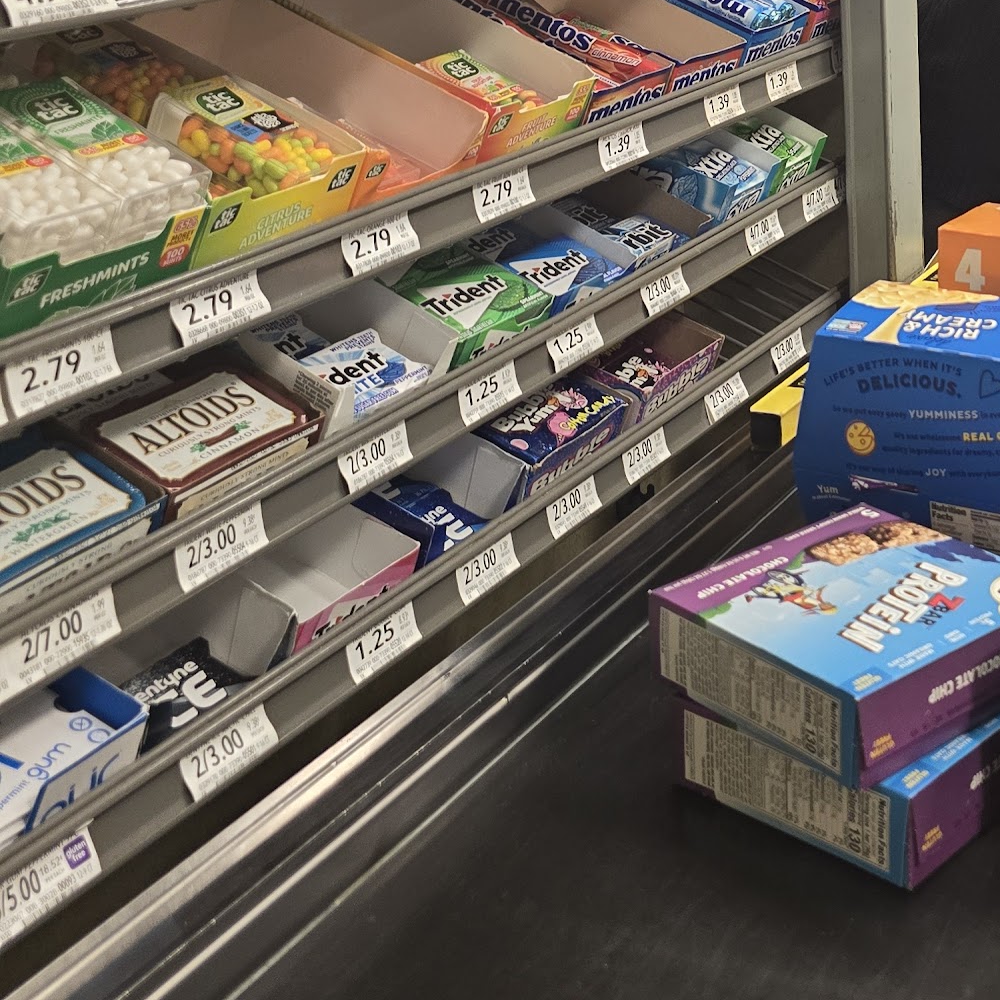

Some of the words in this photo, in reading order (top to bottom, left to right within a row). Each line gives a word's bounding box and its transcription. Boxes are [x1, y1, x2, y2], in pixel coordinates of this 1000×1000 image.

[590, 46, 643, 67] cinnamon
[746, 29, 803, 64] mentos
[770, 72, 788, 89] 1.39
[588, 83, 665, 124] mentos
[708, 95, 730, 114] 1.39
[506, 116, 557, 148] ADVENTURE
[604, 134, 631, 156] 1.39
[480, 183, 512, 208] 2.79
[240, 206, 312, 250] ADVENTURE
[748, 218, 770, 240] 4/7.00
[350, 228, 391, 260] 2.79
[39, 250, 151, 308] FRESHMINTS
[520, 249, 588, 288] Trident
[954, 248, 986, 291] 4
[422, 273, 506, 318] Trident
[645, 277, 672, 302] 2/3.00
[182, 288, 232, 326] 2.79
[903, 308, 998, 331] CREAMY
[903, 319, 922, 334] &
[928, 323, 980, 340] RICH
[553, 332, 586, 356] 1.25
[21, 350, 81, 393] 2.79
[393, 365, 428, 385] PEPPERMINT
[823, 366, 856, 387] LIFE'S
[857, 358, 899, 372] BETTER
[903, 358, 938, 371] WHEN
[942, 363, 962, 378] IT'S
[857, 373, 962, 398] DELICIOUS.
[464, 377, 500, 406] 1.25
[128, 386, 256, 455] ALTOIDS
[908, 410, 978, 420] YUMMINESS
[158, 432, 204, 458] CURIOUSLY
[204, 417, 235, 436] STRONG
[235, 406, 262, 422] MINTS
[199, 426, 260, 460] CINNAMON
[962, 432, 993, 442] REAL
[346, 438, 386, 474] 2/3.00
[627, 440, 654, 468] 2/3.00
[925, 468, 946, 478] JOY
[60, 490, 94, 507] MINTS
[551, 488, 582, 520] 2/3.00
[816, 484, 839, 495] Yum
[932, 502, 967, 516] Nutrition
[932, 512, 954, 522] Facts
[10, 512, 90, 556] WINTERGREEN
[187, 523, 236, 569] 2/3.00
[462, 548, 498, 584] 2/3.00
[724, 556, 789, 590] CHOCOLATE
[697, 581, 724, 599] CHIP
[838, 560, 968, 654] PROTEIN
[22, 610, 82, 664] 2/7.00
[355, 622, 395, 661] 1.25
[928, 680, 954, 704] CHIP
[27, 742, 72, 781] gum
[191, 726, 245, 779] 2/3.00
[66, 840, 87, 858] gluten
[72, 850, 86, 862] free
